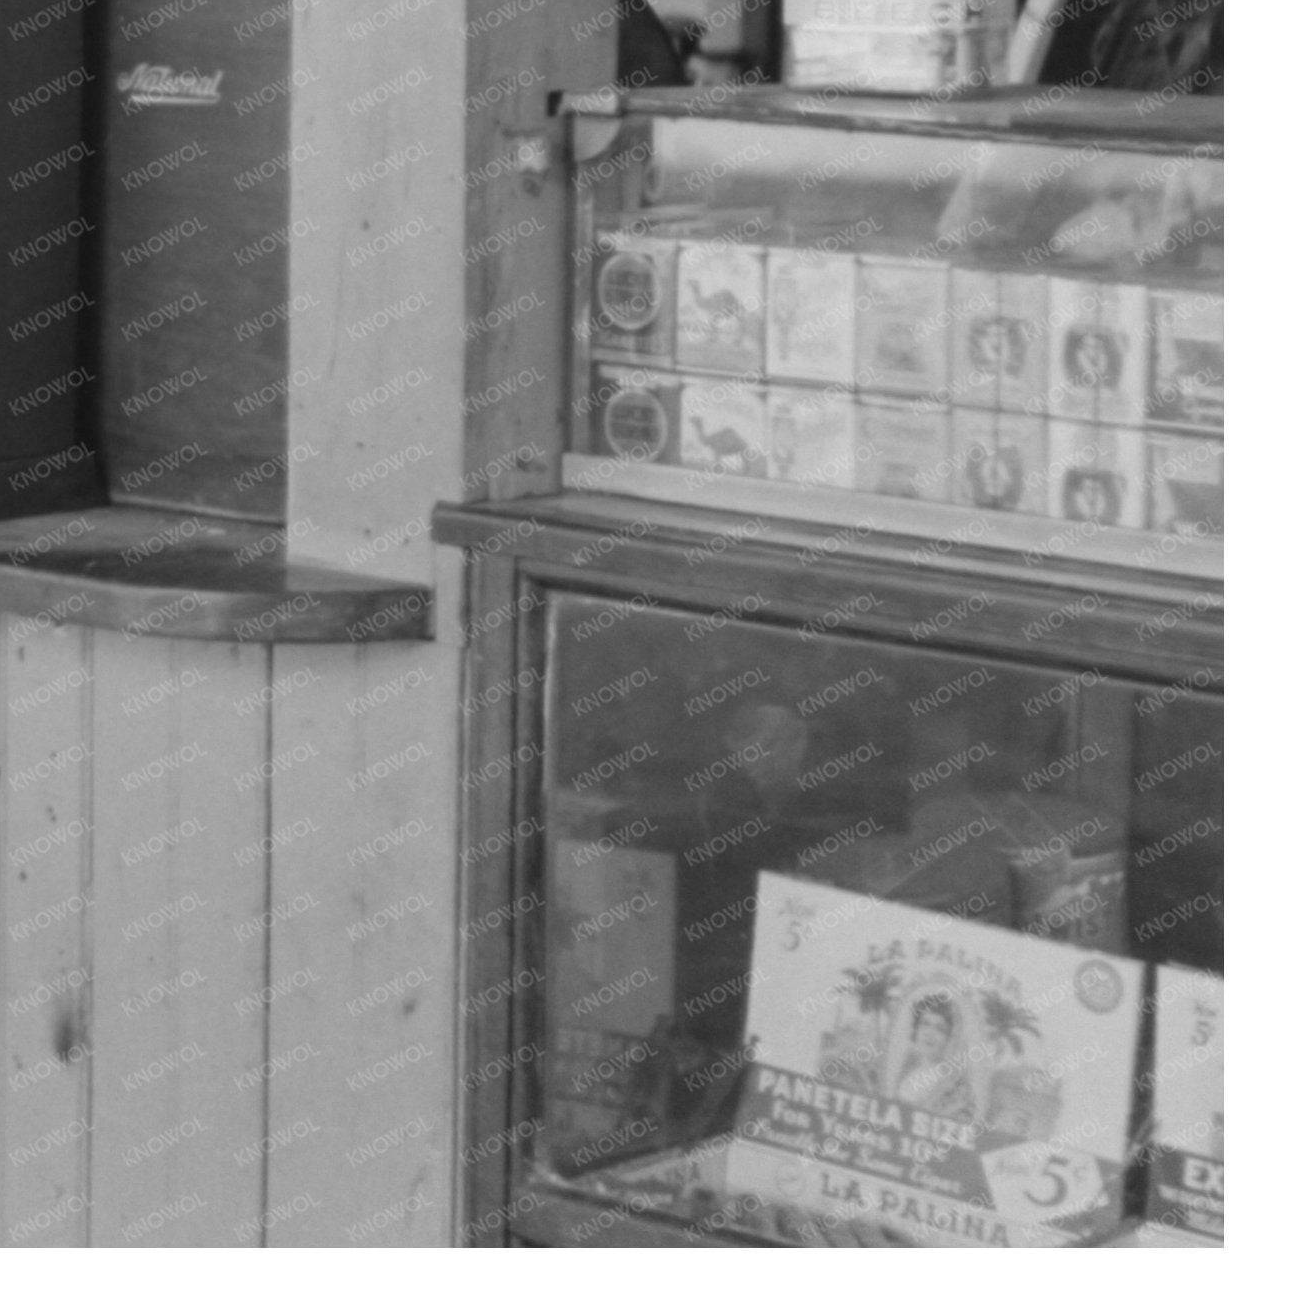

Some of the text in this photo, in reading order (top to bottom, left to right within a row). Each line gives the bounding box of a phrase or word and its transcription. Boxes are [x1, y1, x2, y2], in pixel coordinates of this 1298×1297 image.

[117, 62, 224, 97] National
[868, 939, 907, 965] LA
[918, 939, 1024, 1002] PALINA
[759, 1069, 977, 1151] PANETELA SIZE
[821, 1172, 1010, 1246] LA PALINA
